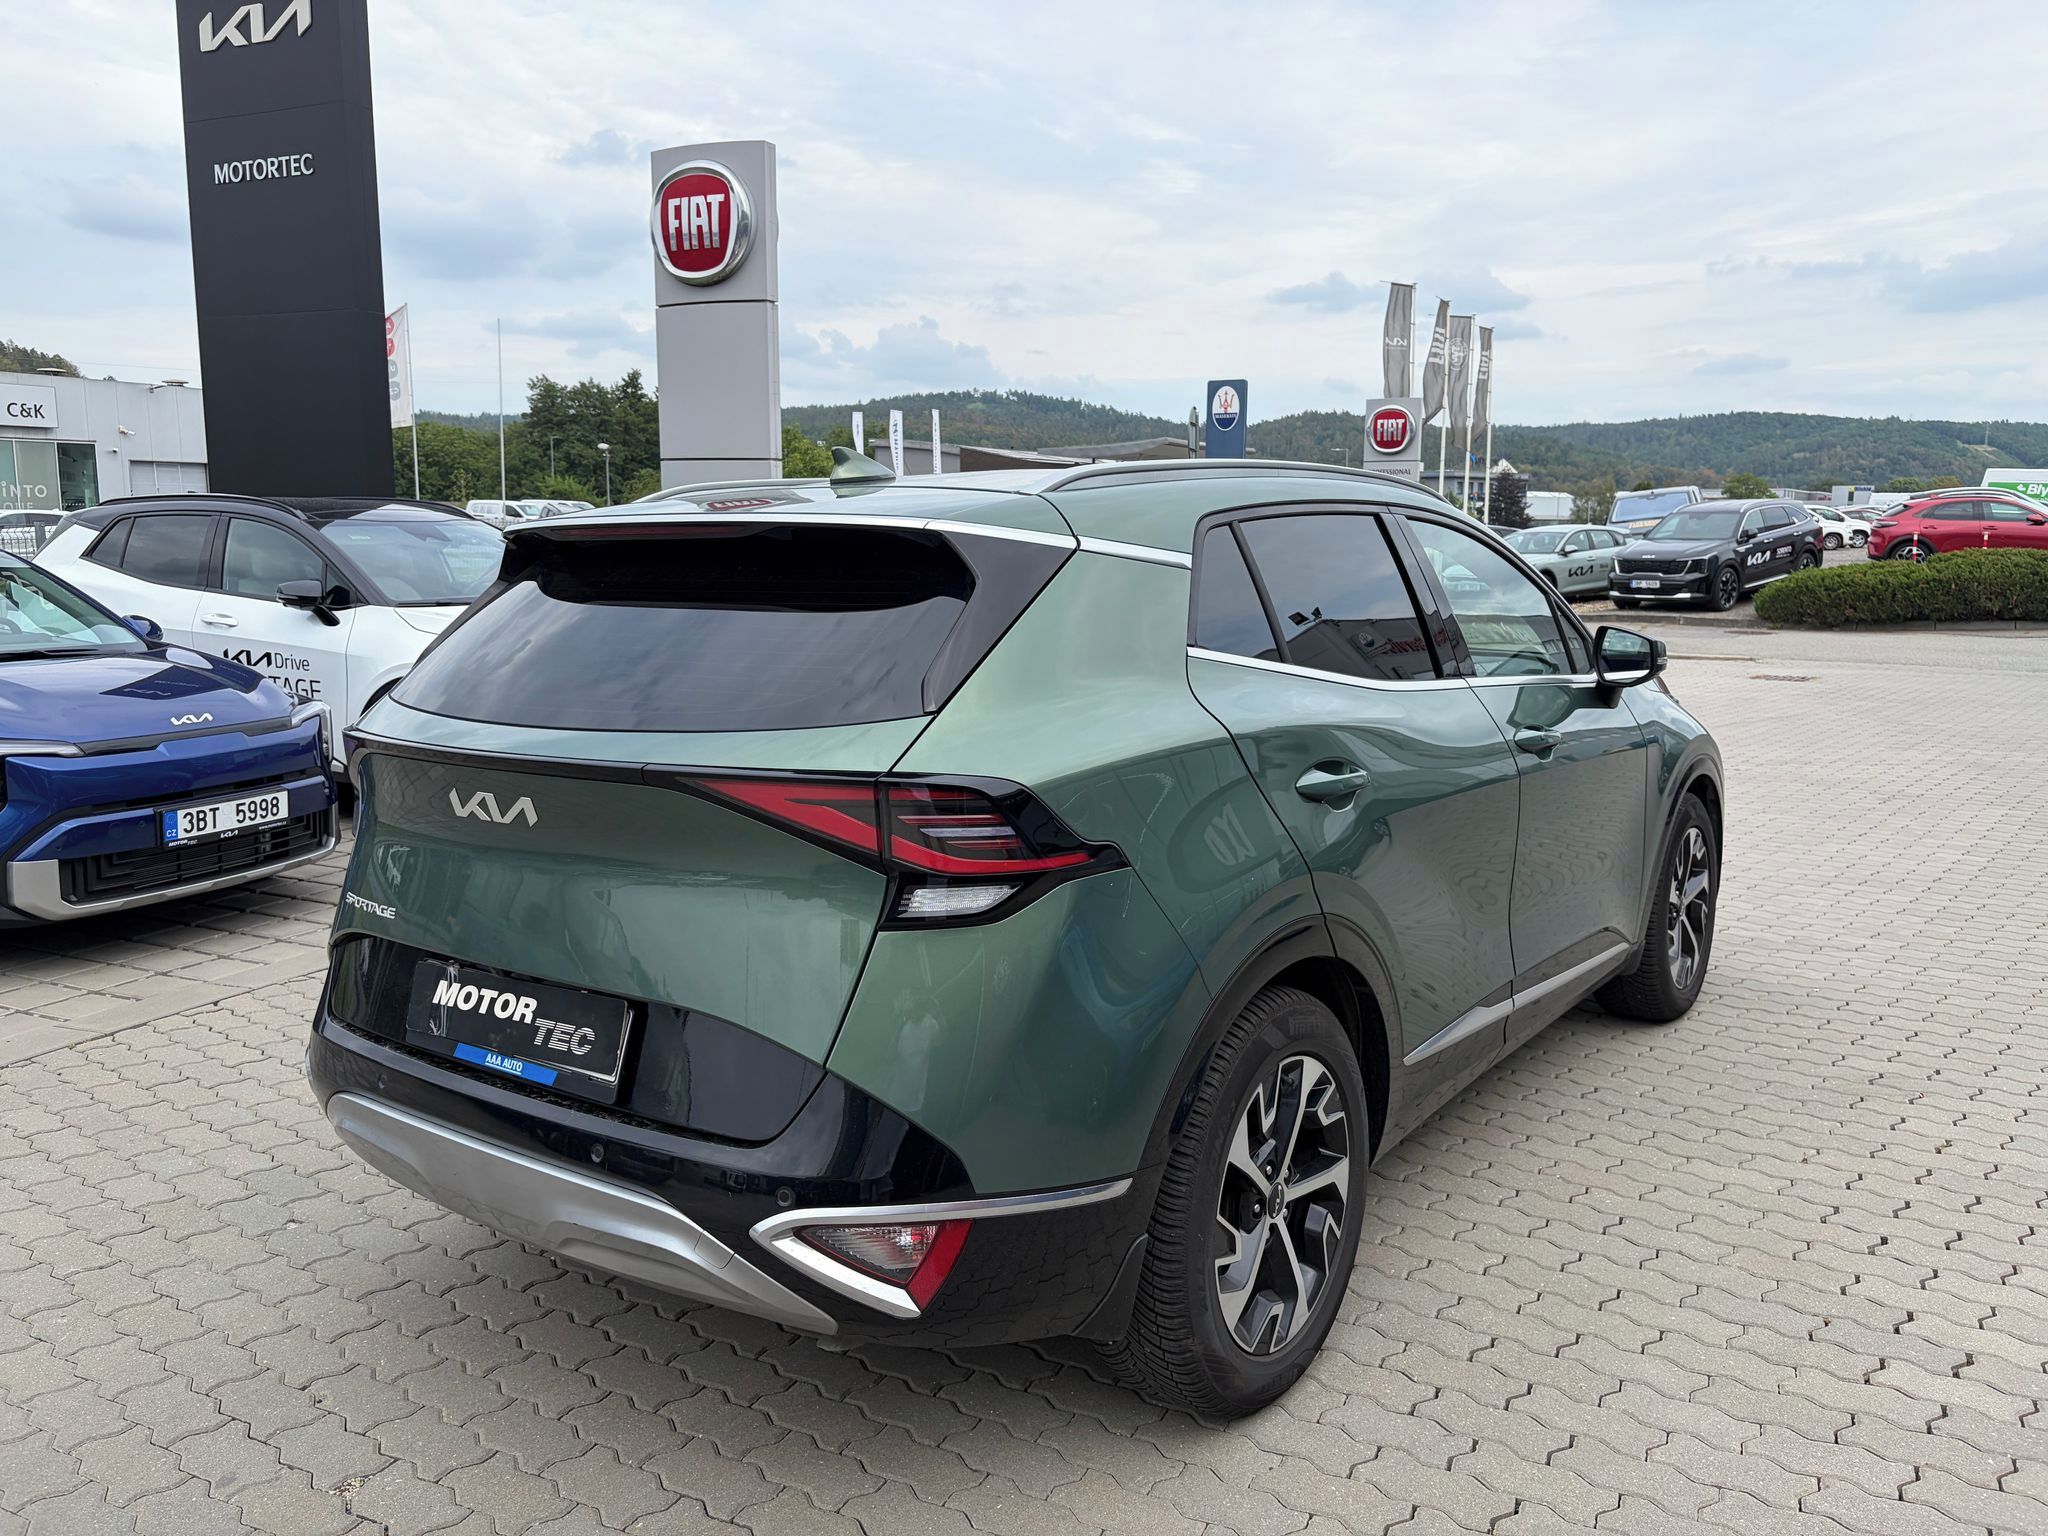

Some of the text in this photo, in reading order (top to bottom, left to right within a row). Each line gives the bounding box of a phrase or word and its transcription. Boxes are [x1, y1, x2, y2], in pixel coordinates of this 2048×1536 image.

[198, 0, 312, 52] KIA
[213, 153, 314, 185] MOTORTEC
[667, 193, 726, 252] FIAT
[6, 402, 46, 419] C&K
[1376, 418, 1406, 442] FIAT
[1747, 550, 1771, 567] KIA
[1568, 565, 1594, 578] KIA
[223, 648, 310, 672] KIA Drive
[170, 712, 214, 726] KIA
[182, 796, 280, 834] 3BT 5998
[448, 787, 539, 828] KIA
[166, 829, 178, 837] CZ
[220, 829, 240, 838] KIA
[345, 891, 397, 920] SPORTAGE
[431, 979, 538, 1025] MOTOR
[533, 1017, 596, 1056] TEC
[485, 1052, 524, 1073] AAA AUTO
